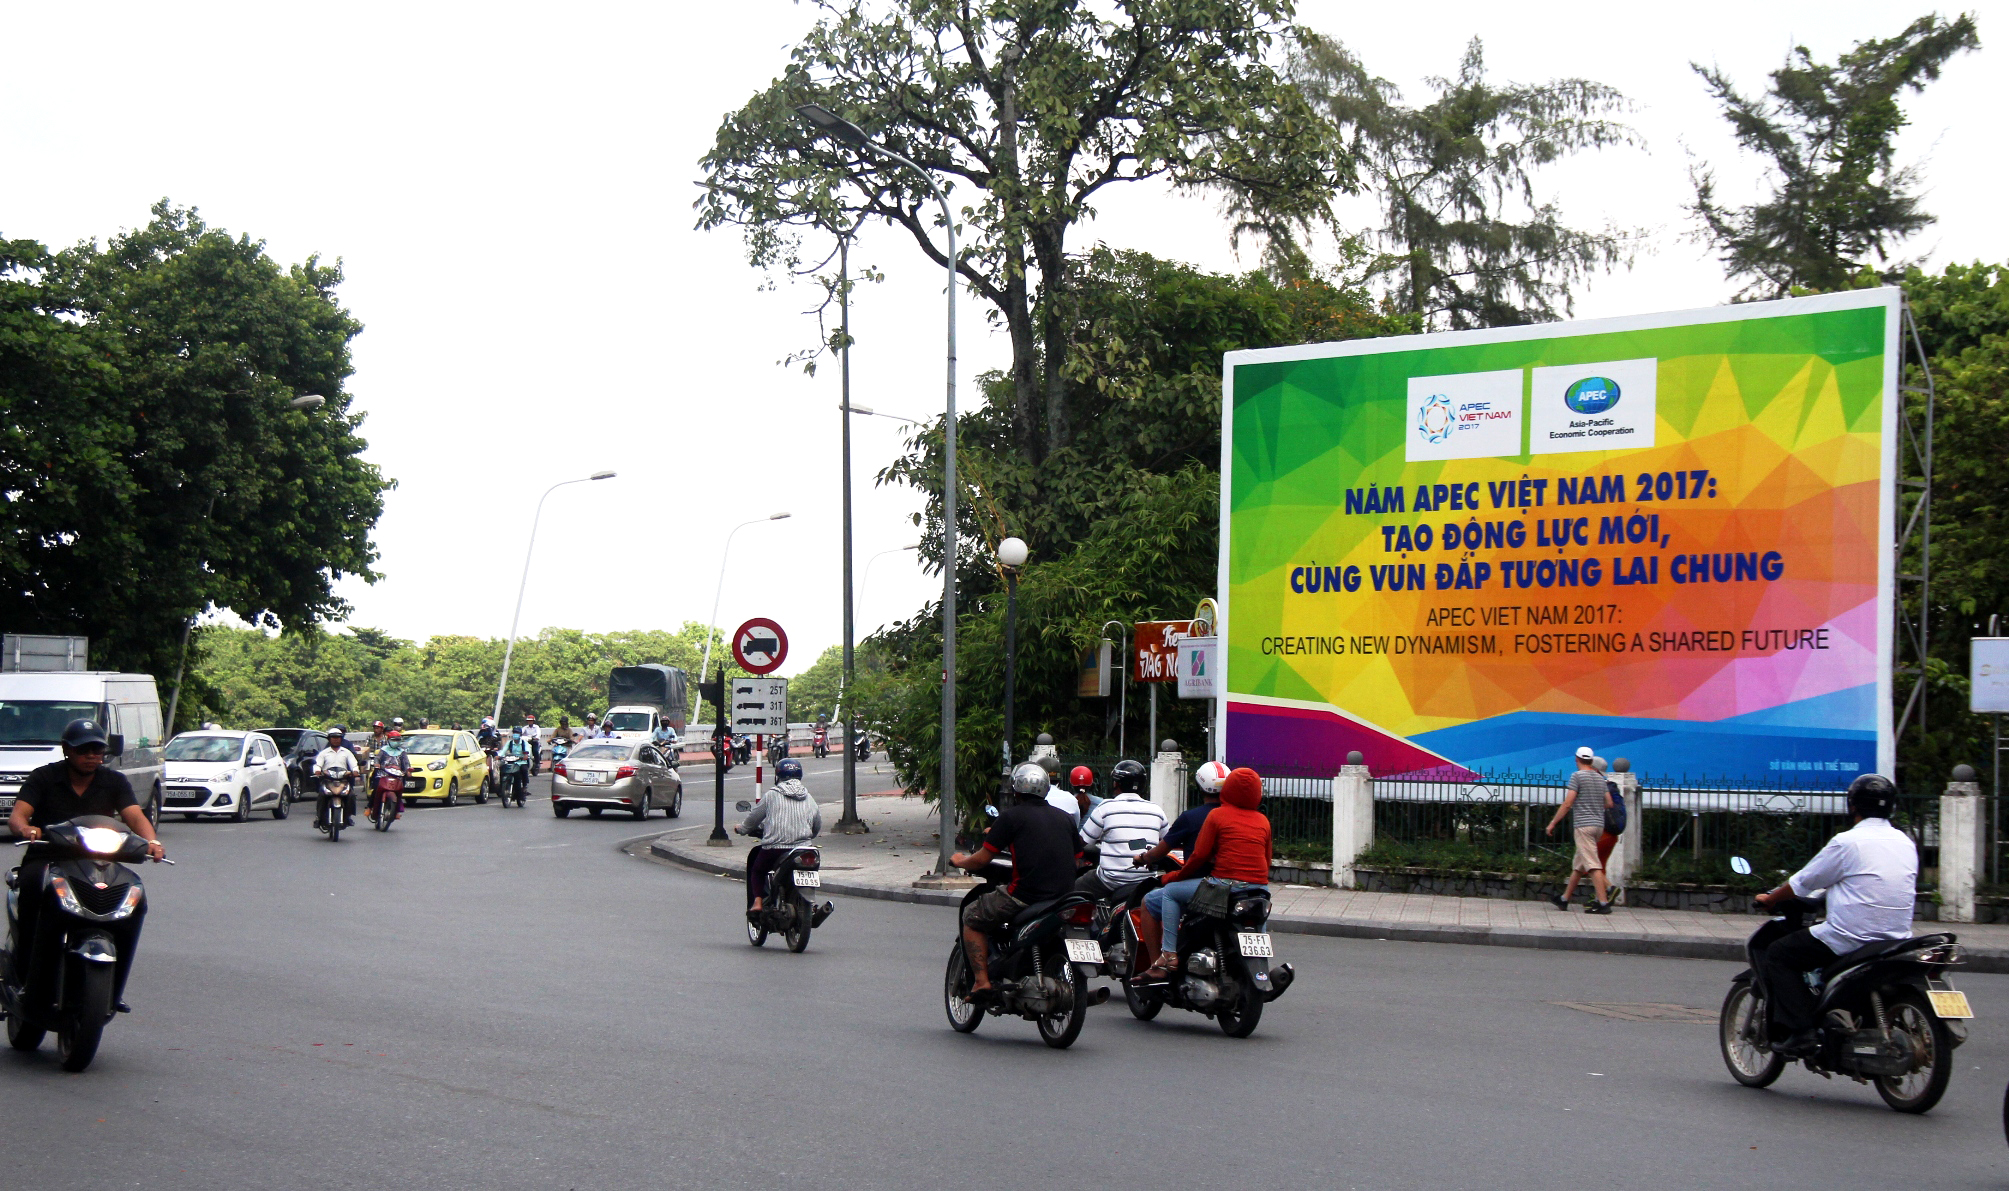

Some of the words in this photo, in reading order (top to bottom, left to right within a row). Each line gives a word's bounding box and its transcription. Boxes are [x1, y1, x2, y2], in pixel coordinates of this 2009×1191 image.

[1578, 390, 1607, 402] APEC
[1459, 402, 1491, 411] APEC
[1458, 412, 1484, 422] VIET
[1485, 411, 1512, 420] NAM
[1458, 423, 1480, 431] 2017
[1569, 418, 1615, 429] Asia-Pacific
[1549, 430, 1586, 439] Economic
[1587, 427, 1635, 438] Cooperation
[1345, 482, 1405, 515] NĂM
[1413, 482, 1479, 512] APEC
[1488, 474, 1548, 515] VIỆT
[1557, 474, 1625, 505] NAM
[1636, 469, 1717, 502] 2017:
[1381, 523, 1433, 559] TẠO
[1442, 516, 1527, 557] ĐỘNG
[1536, 516, 1589, 554] LỰC
[1598, 508, 1671, 549] MỚI,
[1290, 560, 1362, 594] CÙNG
[1369, 563, 1426, 591] VUN
[1434, 552, 1491, 590] ĐẮP
[1500, 557, 1602, 589] TƯƠNG
[1613, 556, 1658, 585] LAI
[1670, 551, 1784, 584] CHUNG
[1426, 607, 1476, 627] APEC
[1480, 606, 1522, 626] VIET
[1527, 605, 1568, 625] NAM
[1573, 604, 1622, 625] 2017:
[1261, 636, 1345, 656] CREATING
[1350, 636, 1390, 655] NEW
[1514, 632, 1626, 654] FOSTERING
[1631, 632, 1645, 653] A
[1649, 631, 1735, 652] SHARED
[1742, 629, 1829, 650] FUTURE
[1185, 679, 1213, 687] AGRIBANK
[770, 686, 783, 695] 25T
[770, 701, 783, 711] 31T
[770, 717, 783, 726] 36T
[1242, 935, 1266, 945] 75-F1
[1242, 945, 1271, 956] 236.63
